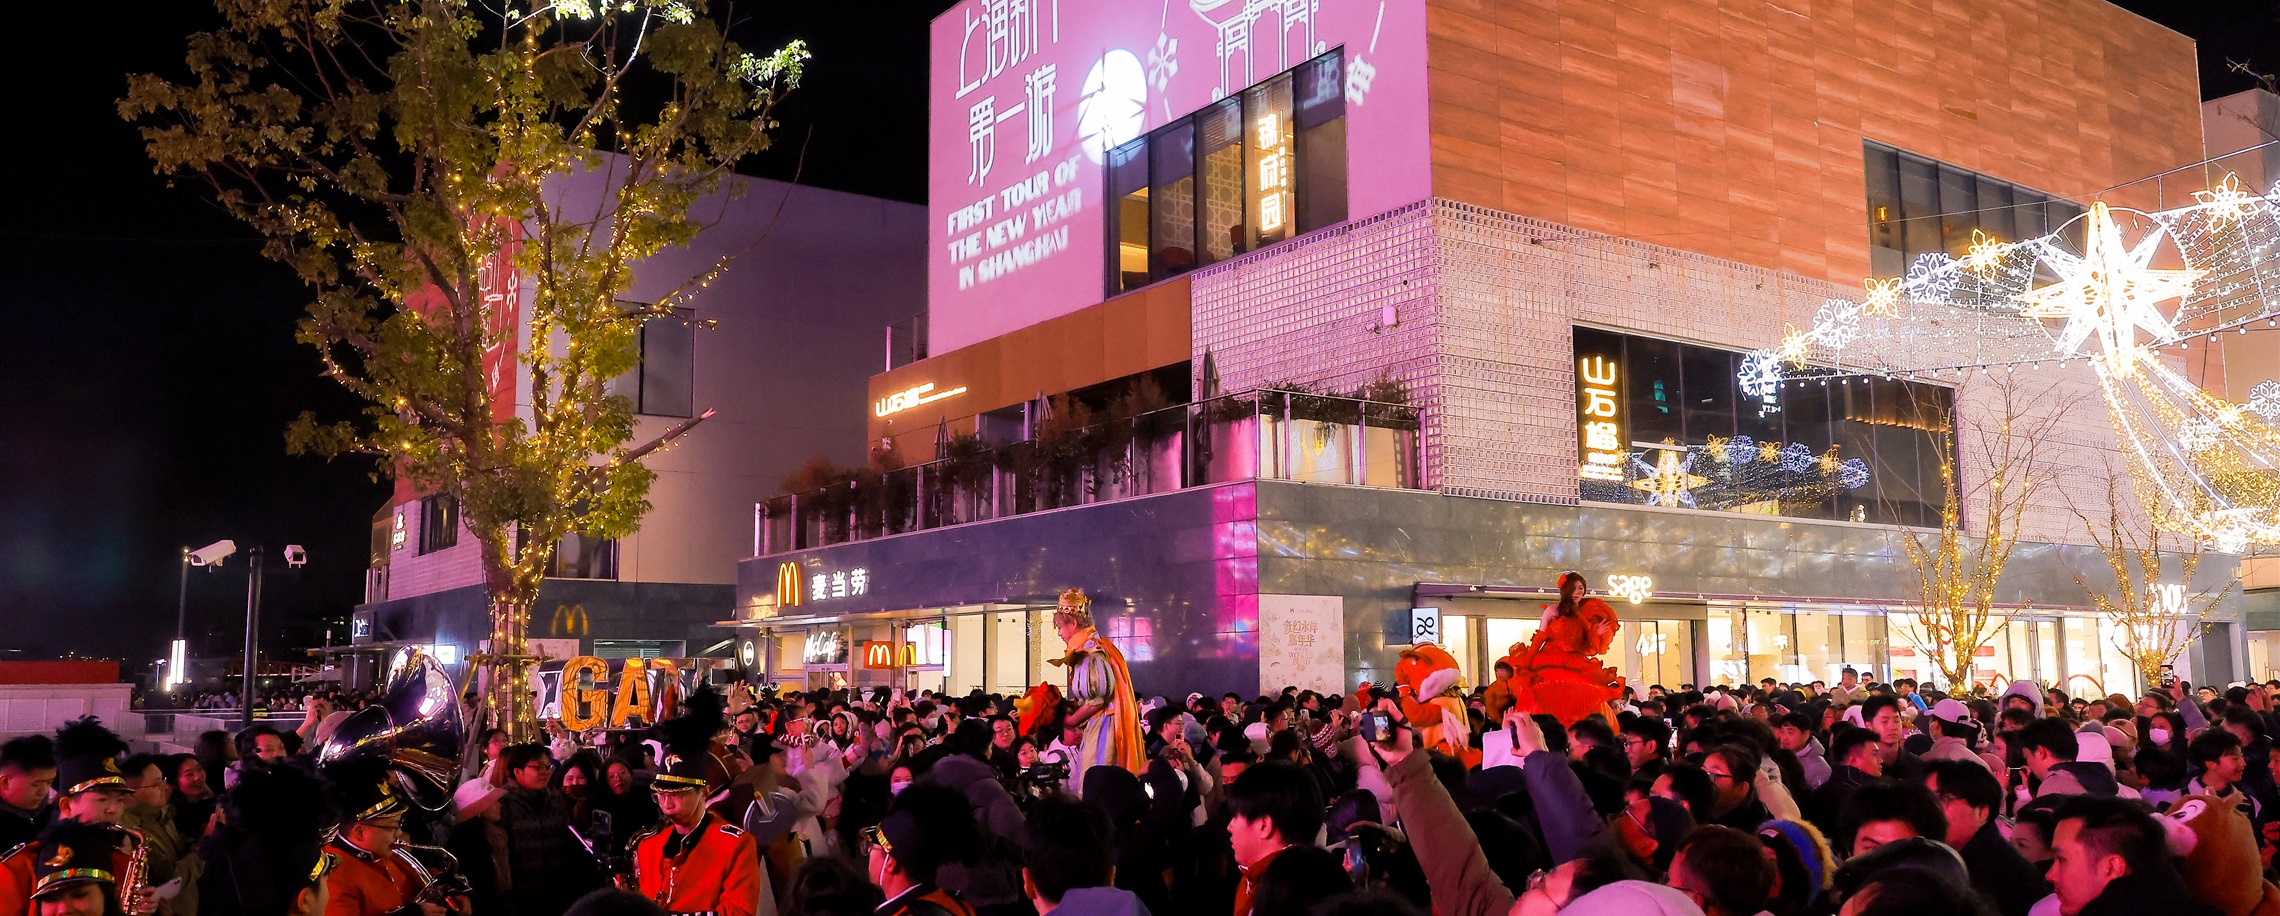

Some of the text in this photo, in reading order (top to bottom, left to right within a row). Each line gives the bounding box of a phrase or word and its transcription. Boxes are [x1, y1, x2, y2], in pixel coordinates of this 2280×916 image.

[968, 62, 1057, 187] 第一游
[947, 154, 1081, 236] FIRST TOUR OF
[948, 187, 1082, 265] THE NEW YEAR
[958, 225, 1069, 291] IN SHANGHAI
[811, 568, 866, 601] 麦当劳
[1607, 574, 1653, 604] sage
[1283, 619, 1319, 634] 奇幻水岸
[1287, 633, 1316, 647] 嘉年华
